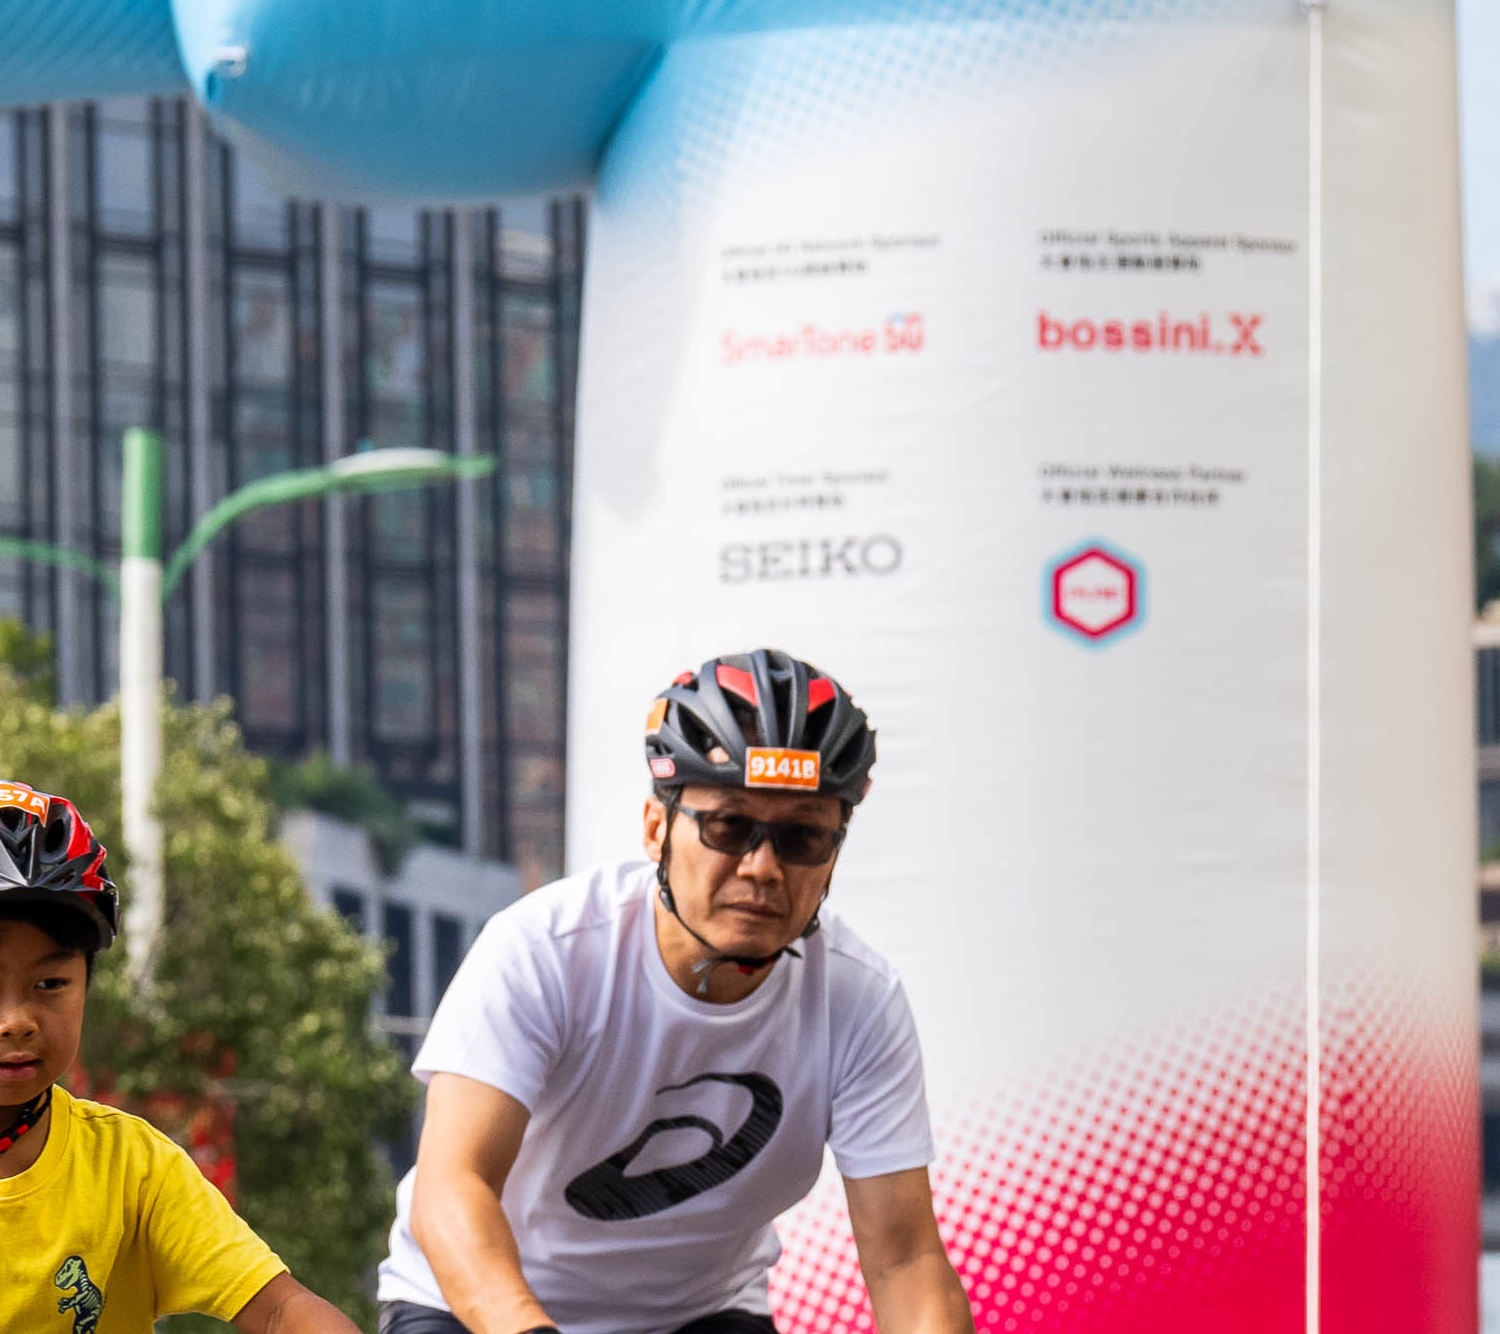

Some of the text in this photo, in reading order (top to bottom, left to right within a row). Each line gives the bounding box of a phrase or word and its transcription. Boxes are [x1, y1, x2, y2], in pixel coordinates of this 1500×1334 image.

[1037, 311, 1265, 356] bossini.X
[720, 534, 902, 584] SEIKO
[751, 754, 816, 779] 9141B
